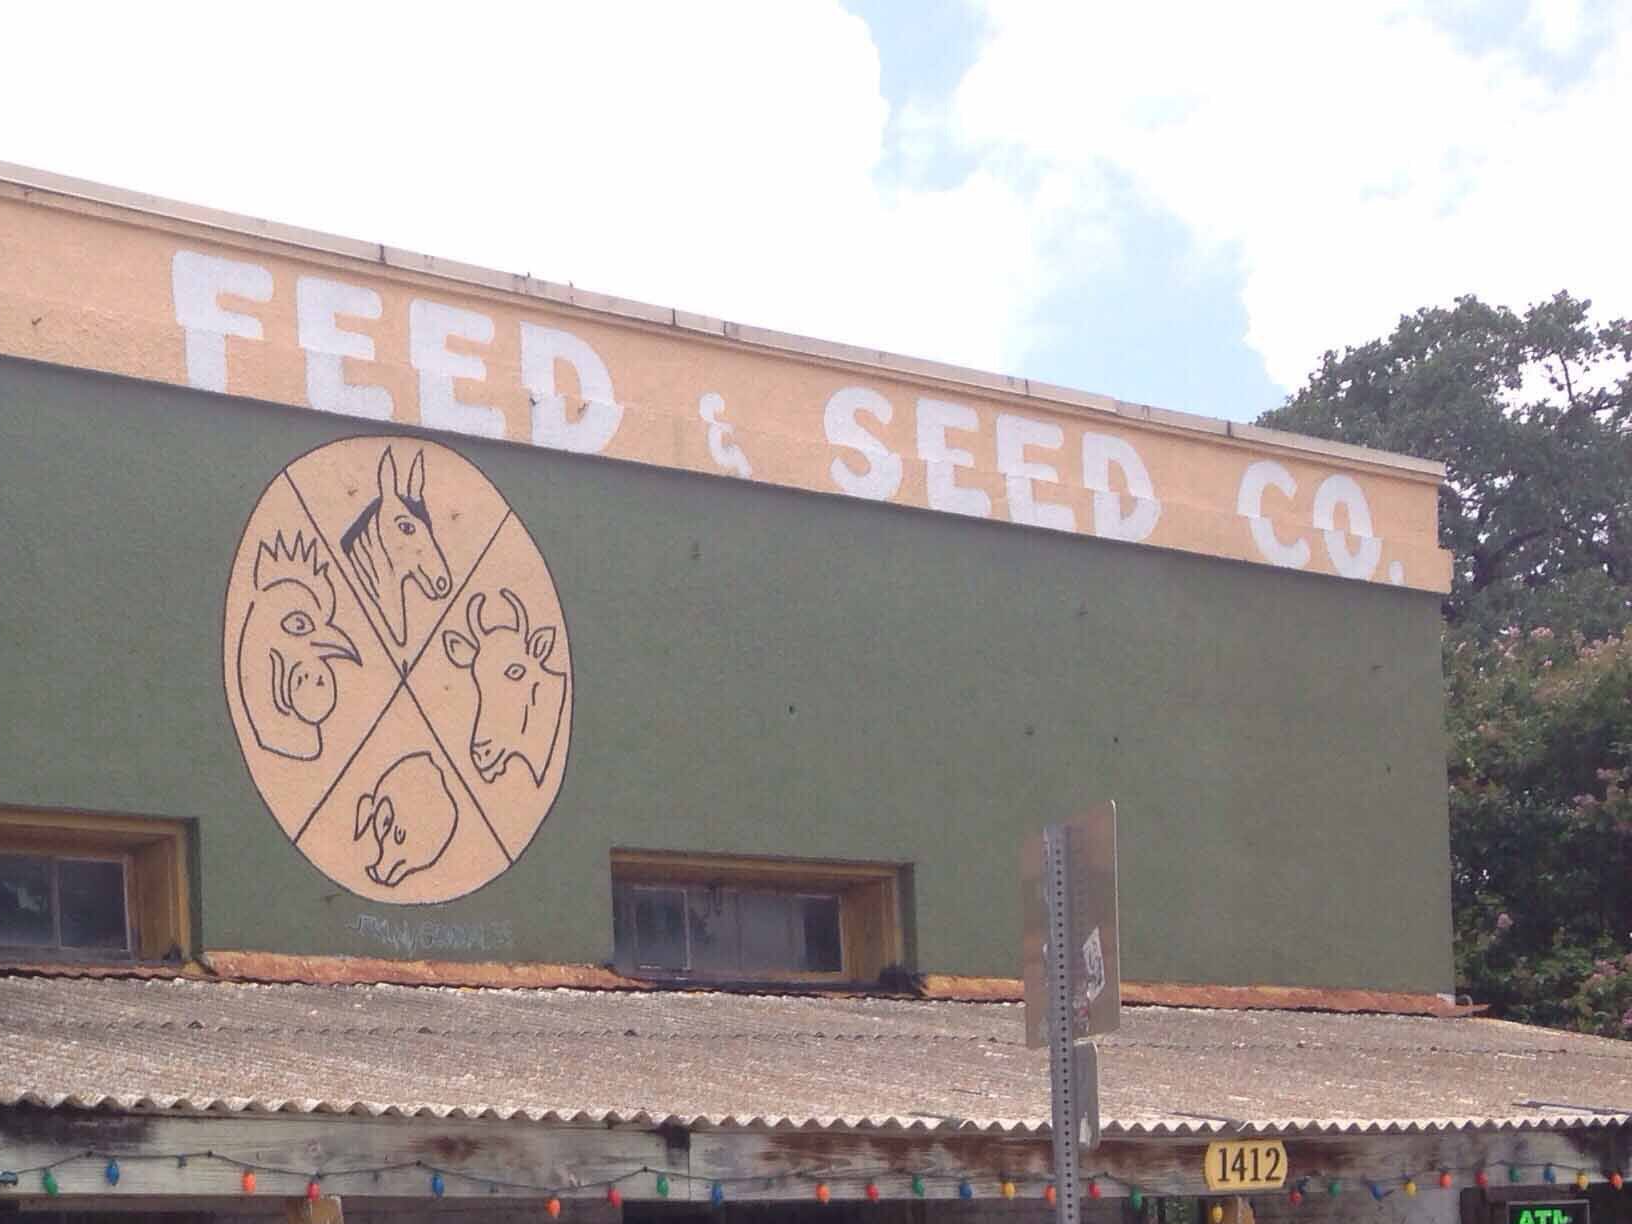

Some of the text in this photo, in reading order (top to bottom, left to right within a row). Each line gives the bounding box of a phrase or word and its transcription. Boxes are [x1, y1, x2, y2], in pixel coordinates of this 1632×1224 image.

[170, 249, 624, 455] FEED
[698, 391, 752, 479] &
[823, 387, 1162, 543] SEED
[1236, 459, 1405, 586] CO.
[1217, 1146, 1282, 1183] 1412
